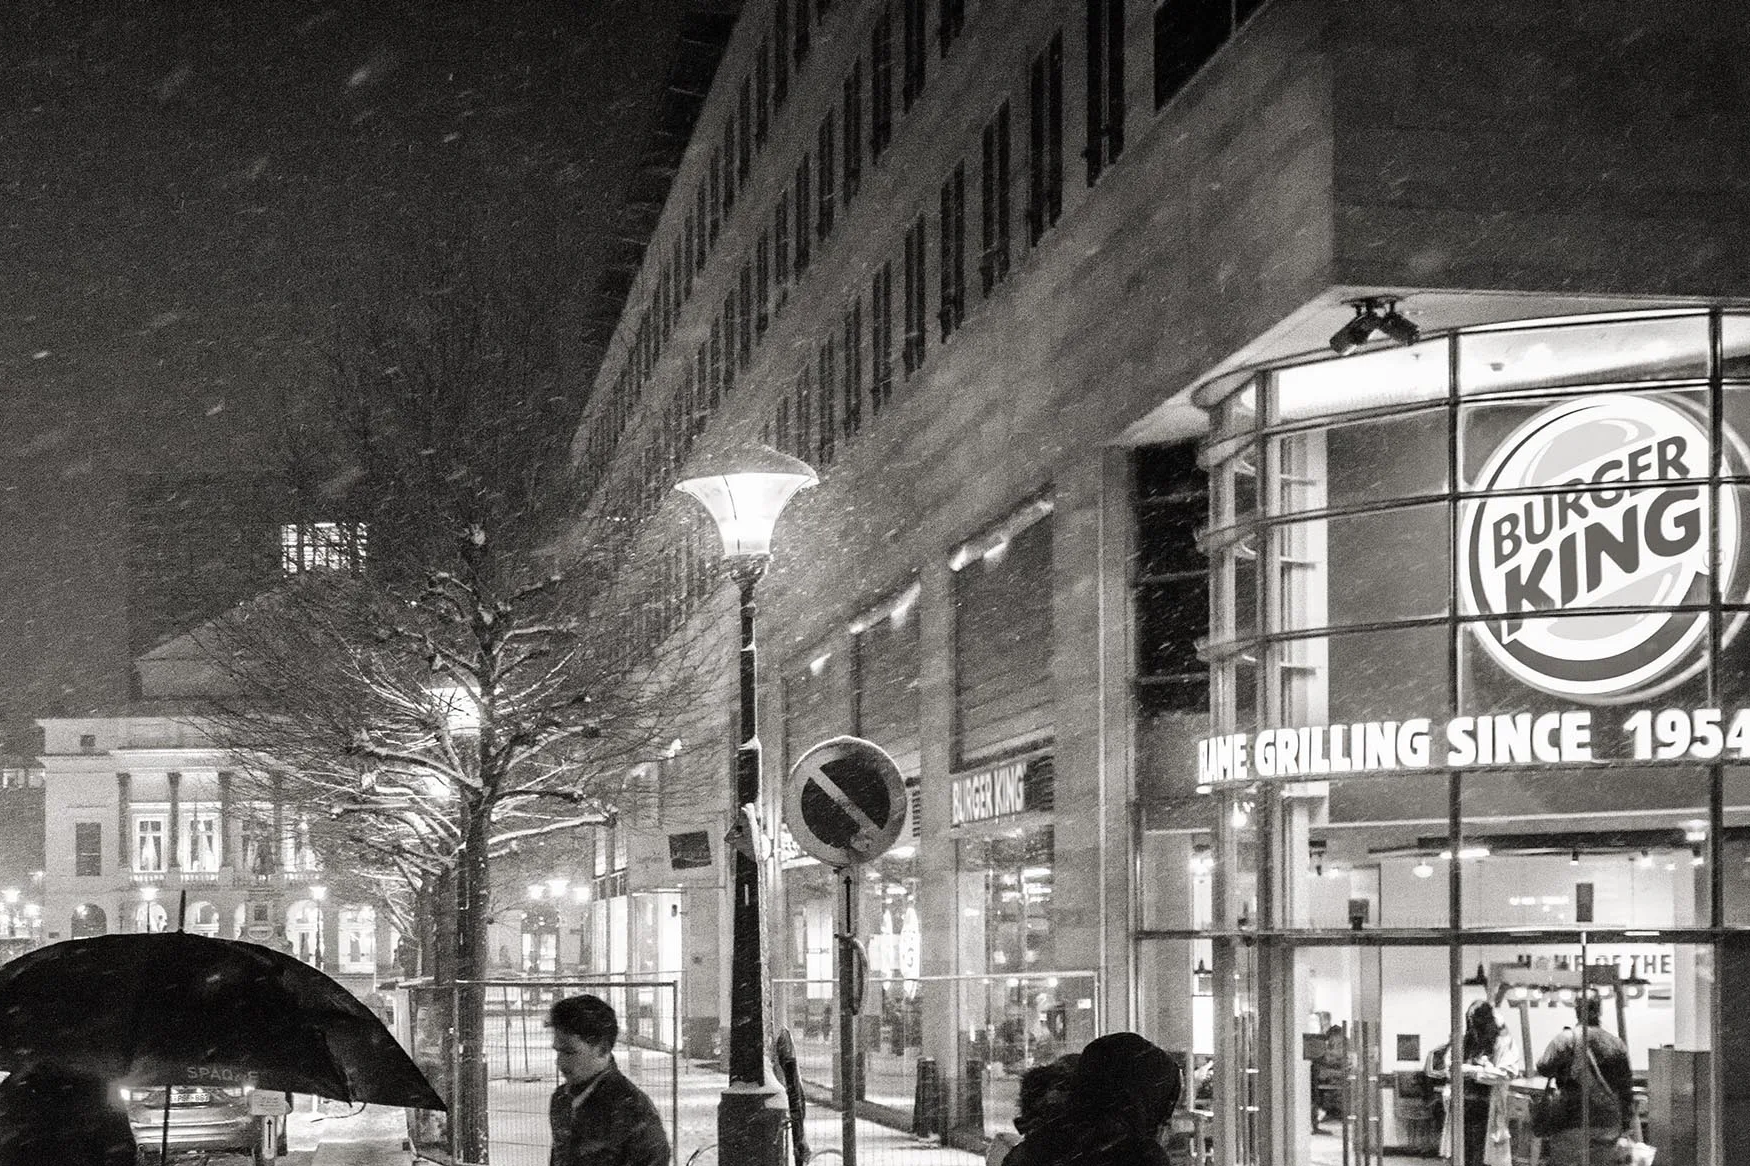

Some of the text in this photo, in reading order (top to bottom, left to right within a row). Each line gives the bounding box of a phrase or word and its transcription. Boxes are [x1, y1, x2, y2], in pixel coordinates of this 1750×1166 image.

[1493, 436, 1691, 569] BURGER
[1504, 488, 1701, 638] KING
[1254, 718, 1433, 776] GRILLING
[1446, 711, 1593, 766] SINCE
[1622, 708, 1750, 760] 1954
[952, 762, 1027, 824] BURGER KING
[1629, 954, 1673, 974] THE
